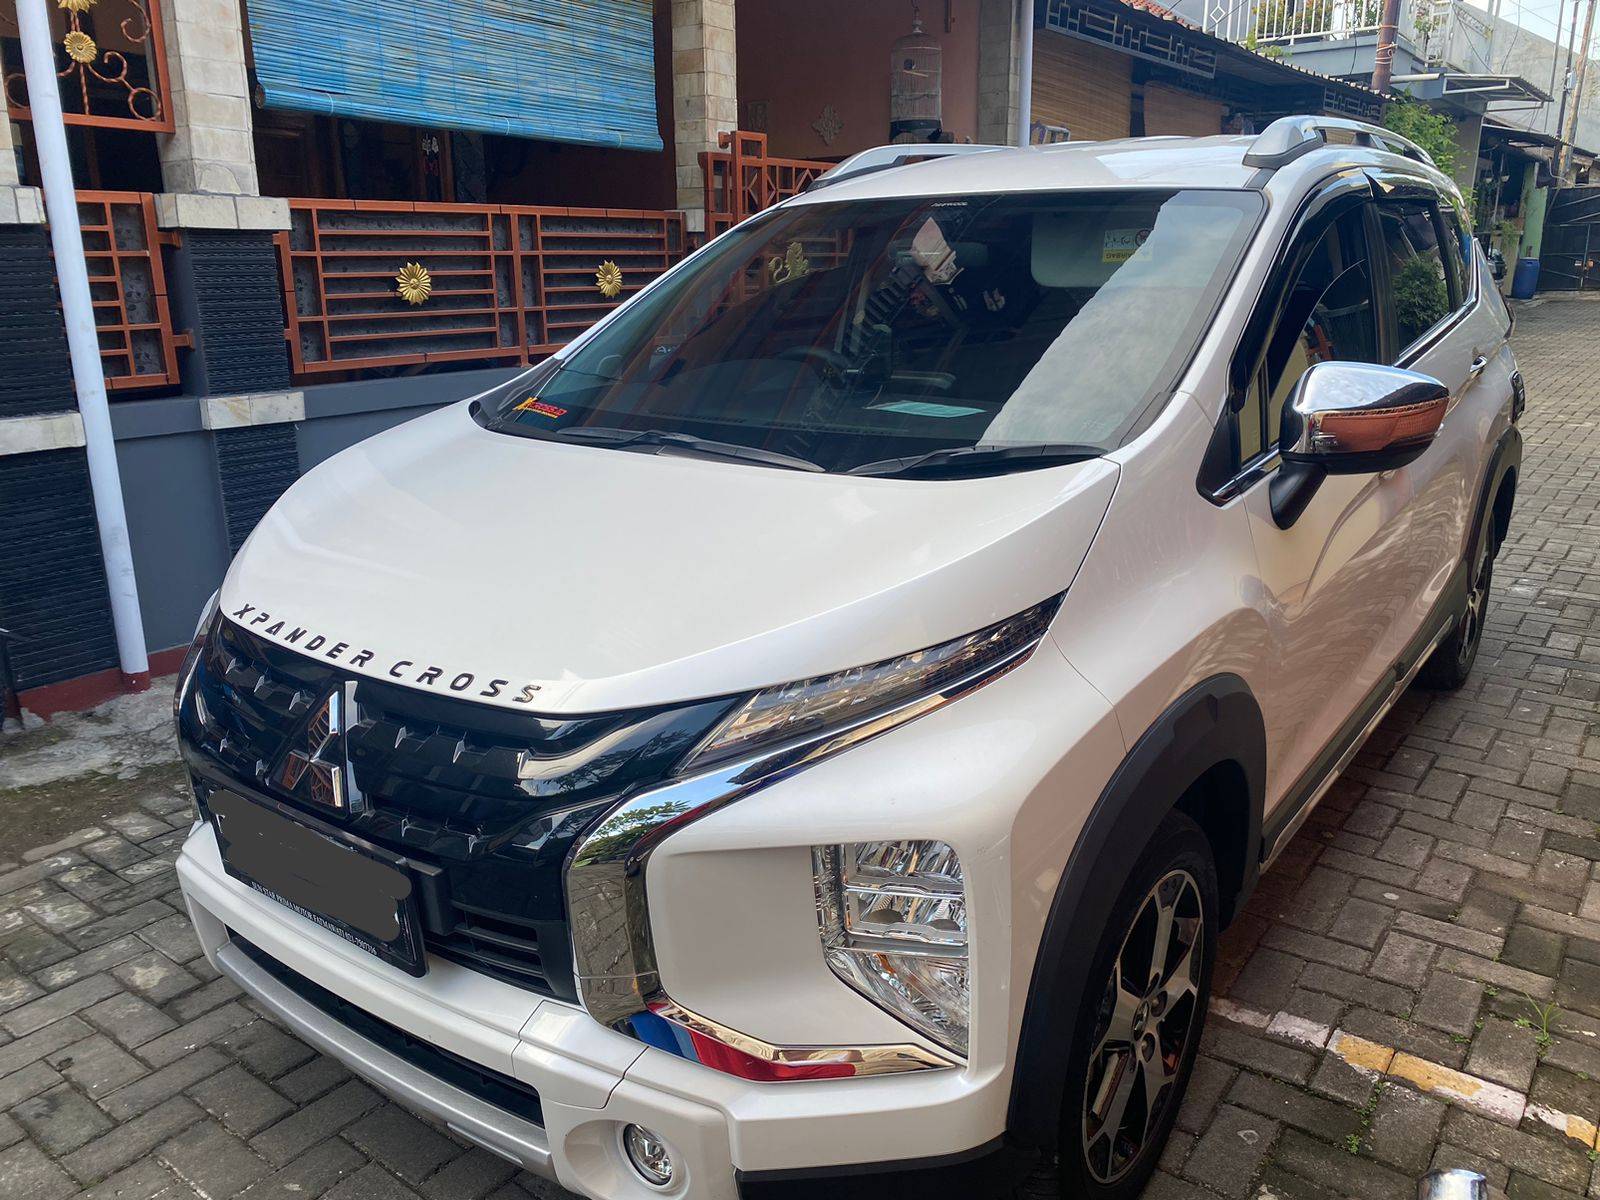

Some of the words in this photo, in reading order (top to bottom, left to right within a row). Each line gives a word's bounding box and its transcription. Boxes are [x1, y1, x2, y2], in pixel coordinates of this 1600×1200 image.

[232, 603, 375, 668] XPANDER
[389, 660, 542, 703] CROSS
[293, 903, 313, 920] MOTOR
